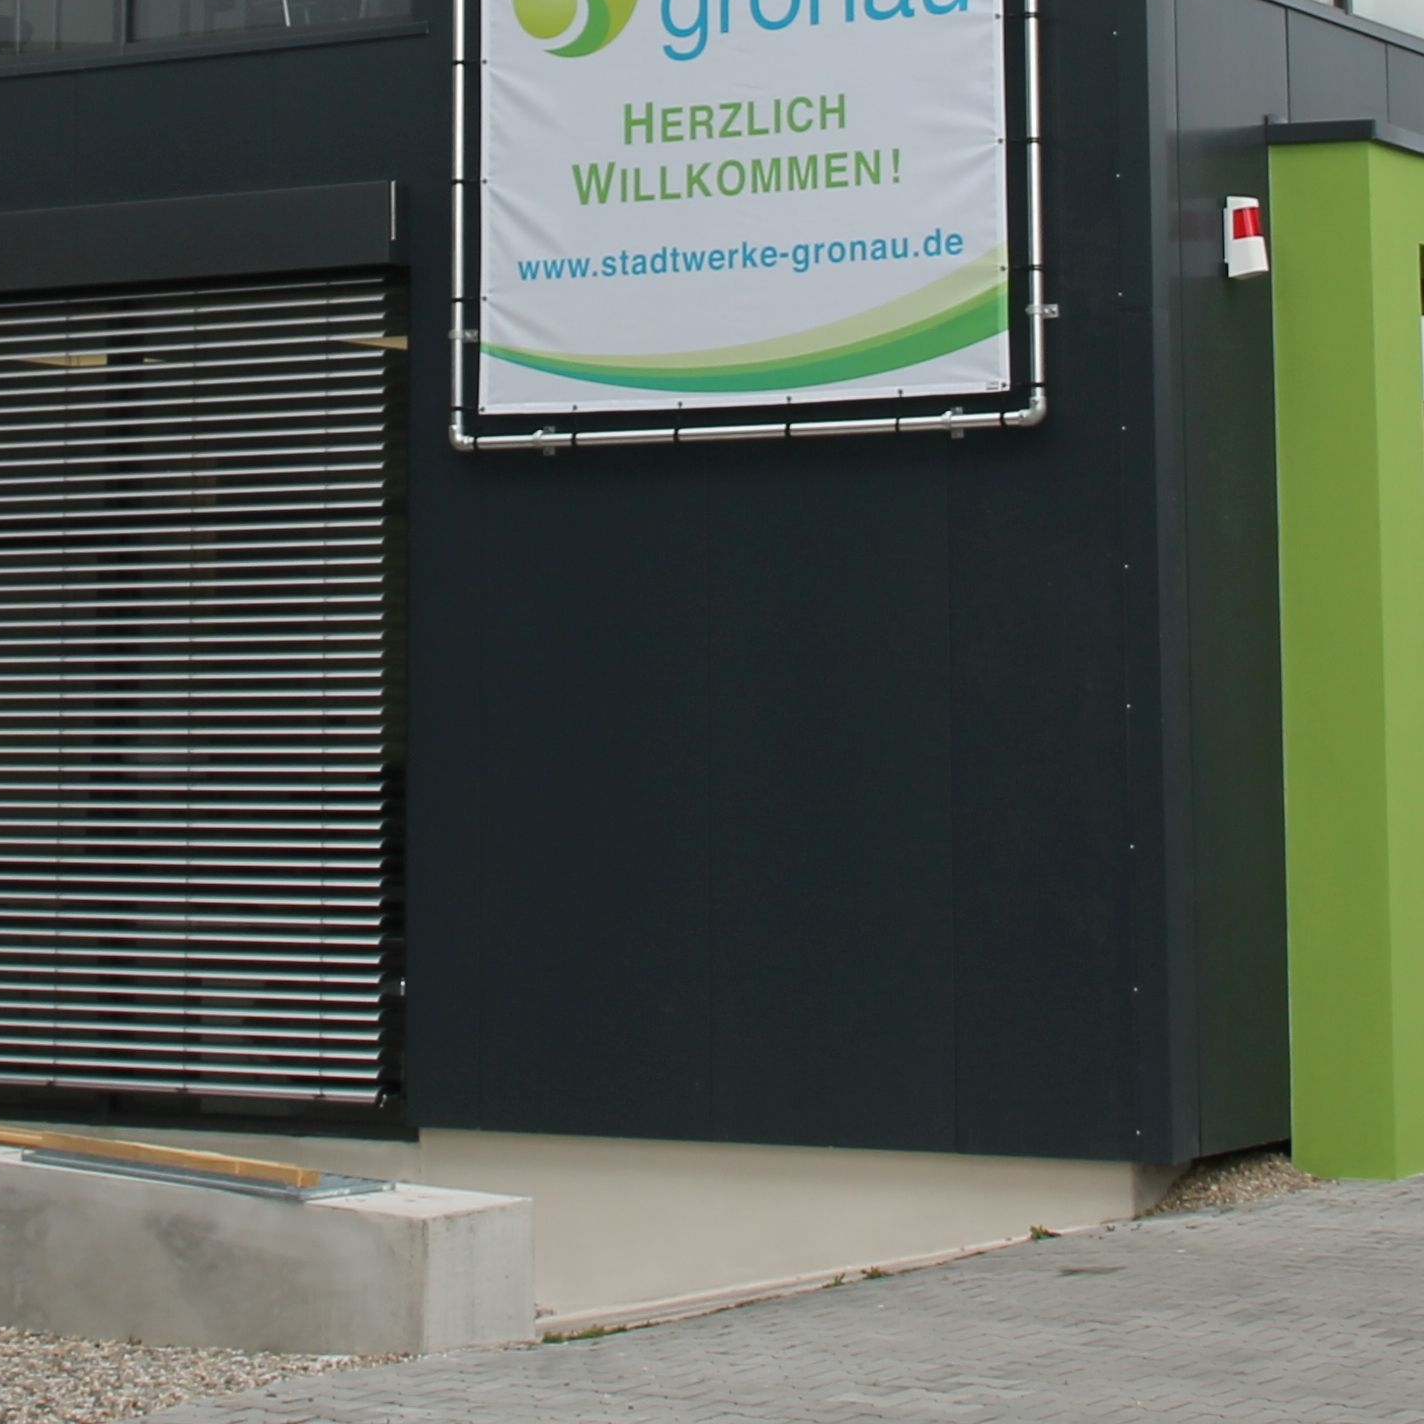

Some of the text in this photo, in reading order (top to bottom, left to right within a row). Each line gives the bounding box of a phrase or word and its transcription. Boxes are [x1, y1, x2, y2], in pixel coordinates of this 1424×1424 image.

[622, 93, 846, 146] HERZLICH
[571, 147, 901, 206] WILLKOMMEN!
[517, 228, 964, 282] www.stadtwerke-gronau.de
